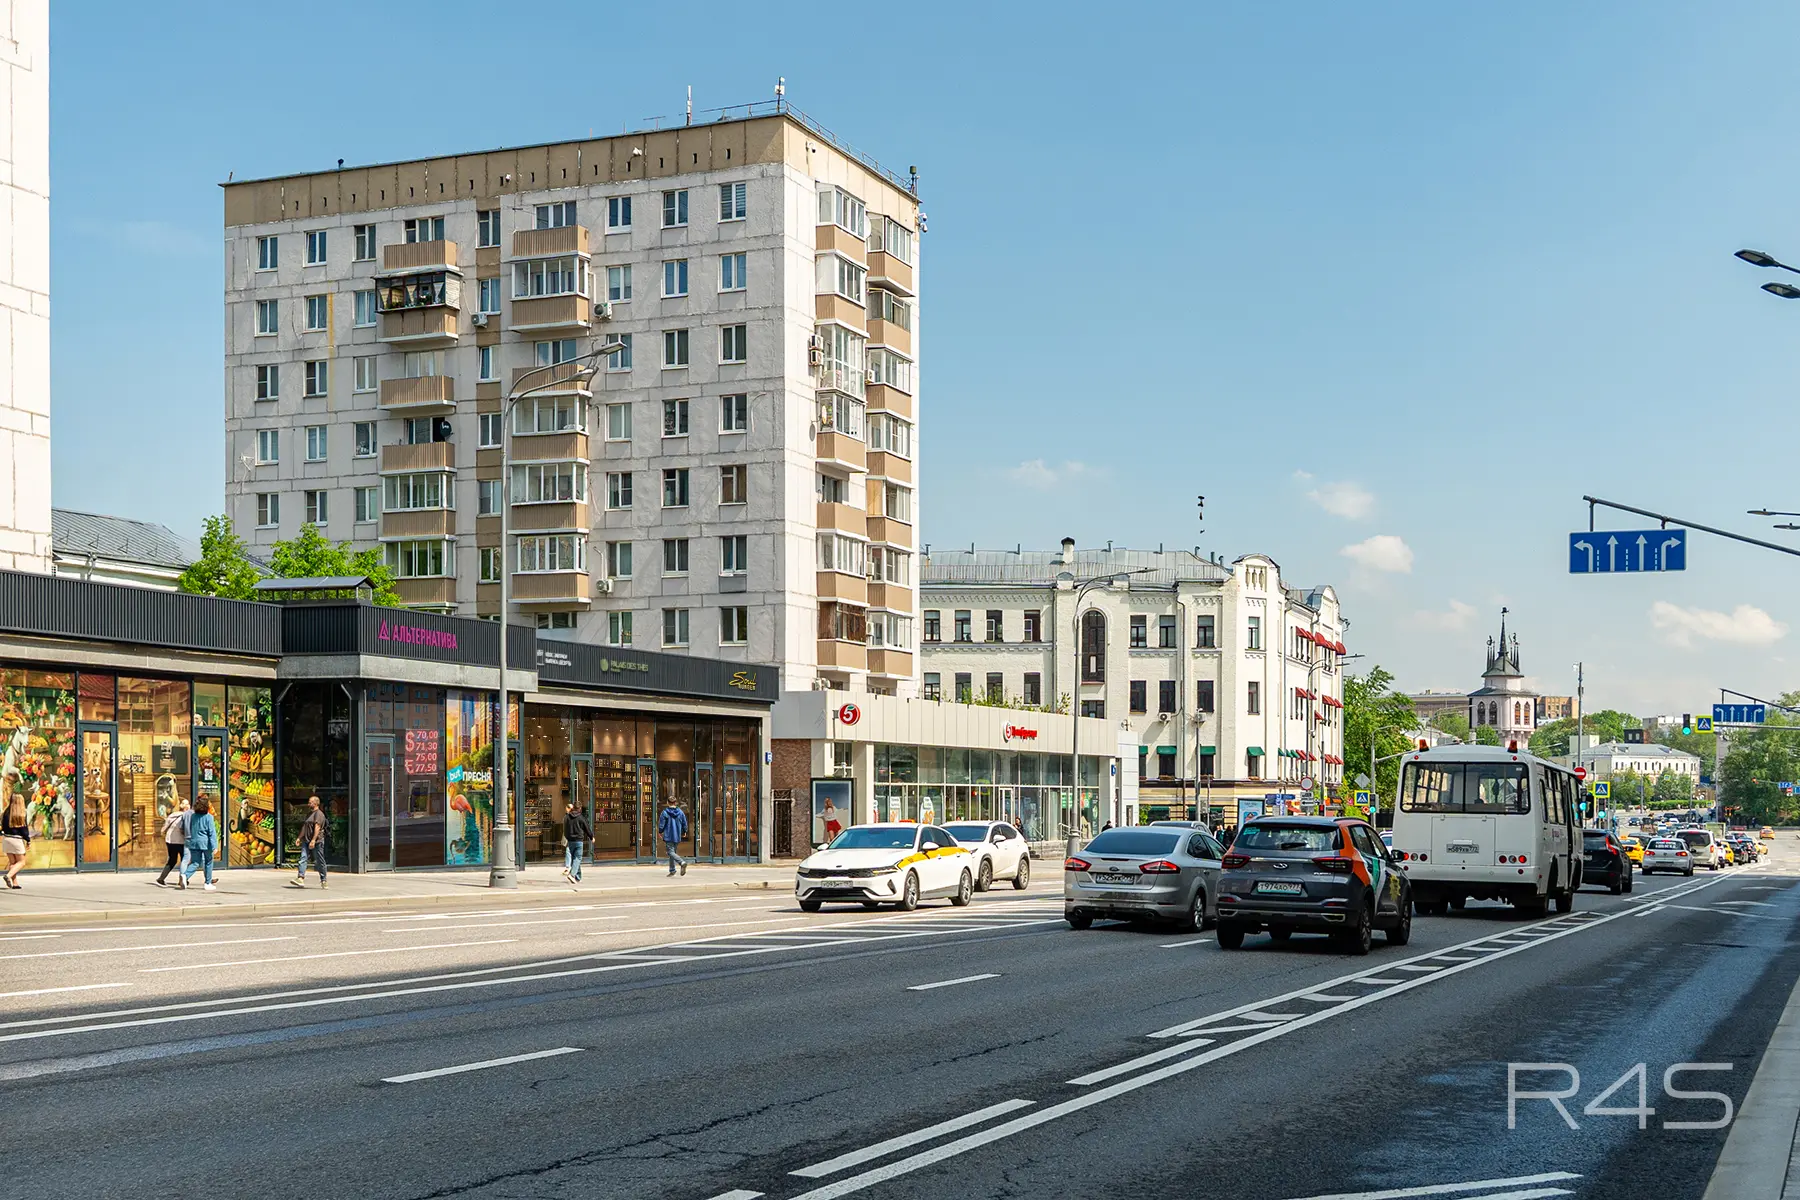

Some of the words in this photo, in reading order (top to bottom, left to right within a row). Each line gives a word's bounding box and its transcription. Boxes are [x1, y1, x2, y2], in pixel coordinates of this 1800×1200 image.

[392, 624, 458, 649] АЛЬТЕРНАТИВА
[728, 671, 757, 686] Soul
[843, 705, 855, 722] 5
[416, 730, 439, 740] 70,00
[415, 753, 437, 763] 75,00
[462, 771, 492, 782] ПРЕСНЯ
